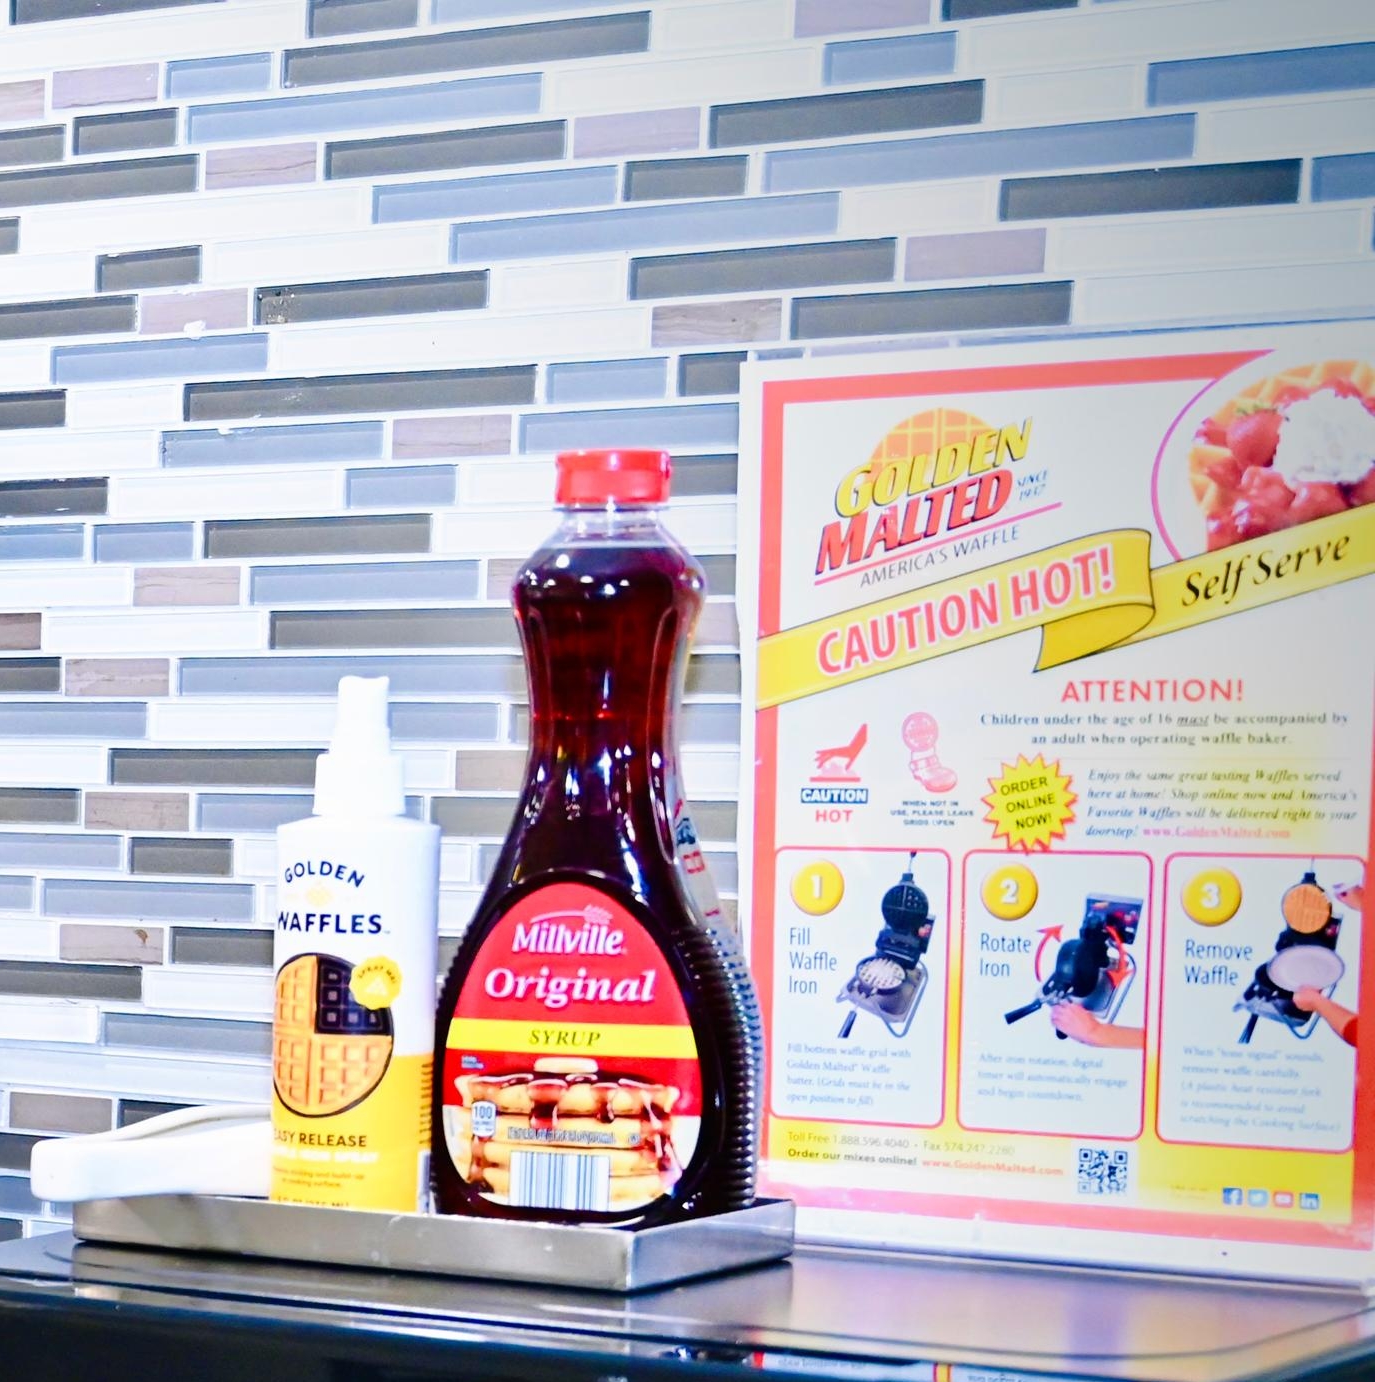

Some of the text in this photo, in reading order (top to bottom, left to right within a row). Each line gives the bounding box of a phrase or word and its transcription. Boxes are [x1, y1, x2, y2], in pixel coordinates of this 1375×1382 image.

[834, 416, 1033, 519] GOLDEN
[815, 468, 1013, 575] MALTED
[860, 525, 1020, 588] AMERICA'S WAFFLE
[1180, 535, 1352, 608] Self Serve
[817, 544, 1115, 675] CAUTION HOT!
[1061, 678, 1244, 703] ATTENTION!
[980, 713, 1040, 726] Children
[1043, 714, 1083, 726] under
[1087, 713, 1108, 725] the
[1112, 715, 1135, 728] age
[1139, 712, 1153, 725] of
[1157, 712, 1173, 725] 16
[1213, 712, 1230, 725] be
[1234, 712, 1328, 728] accompanied
[1031, 734, 1047, 745] an
[1051, 732, 1087, 745] adult
[1091, 732, 1126, 745] when
[1129, 733, 1196, 747] operating
[1201, 731, 1243, 745] waffle
[1000, 776, 1049, 796] ORDER
[1087, 769, 1121, 784] Enjoy
[1124, 769, 1144, 781] the
[1178, 771, 1208, 783] great
[1211, 770, 1251, 783] tasting
[1254, 769, 1300, 784] Waffles
[802, 789, 867, 803] CAUTION
[1005, 793, 1056, 814] ONLINE
[1087, 787, 1113, 800] here
[1115, 788, 1129, 800] at
[1202, 788, 1239, 800] online
[1242, 791, 1268, 801] now
[1270, 788, 1294, 801] and
[815, 809, 854, 823] HOT
[1015, 813, 1052, 830] NOW!
[1087, 806, 1134, 818] Favorite
[1138, 806, 1182, 820] Waffles
[1225, 807, 1278, 820] delivered
[284, 860, 365, 888] GOLDEN
[811, 874, 822, 899] 1
[1000, 879, 1019, 905] 2
[1200, 883, 1221, 909] 3
[278, 911, 382, 935] WAFFLES
[512, 922, 624, 956] Millville
[790, 927, 811, 945] Fill
[979, 932, 1032, 954] Rotate
[1185, 939, 1253, 961] Remove
[789, 951, 838, 972] Waffle
[979, 958, 1011, 977] Iron
[789, 975, 817, 994] Iron
[1183, 966, 1239, 986] Waffle
[484, 966, 656, 1009] Original
[528, 1028, 601, 1048] SYRUP
[804, 1043, 837, 1054] bottom
[868, 1048, 887, 1059] grid
[785, 1059, 821, 1071] Golden
[474, 1105, 492, 1119] 100
[299, 1133, 367, 1148] RELEASE
[787, 1131, 807, 1142] Toll
[808, 1132, 830, 1144] Free
[923, 1140, 941, 1152] Fax
[787, 1148, 819, 1160] Order
[822, 1152, 841, 1161] our
[843, 1152, 875, 1163] mixes
[877, 1156, 917, 1166] online!
